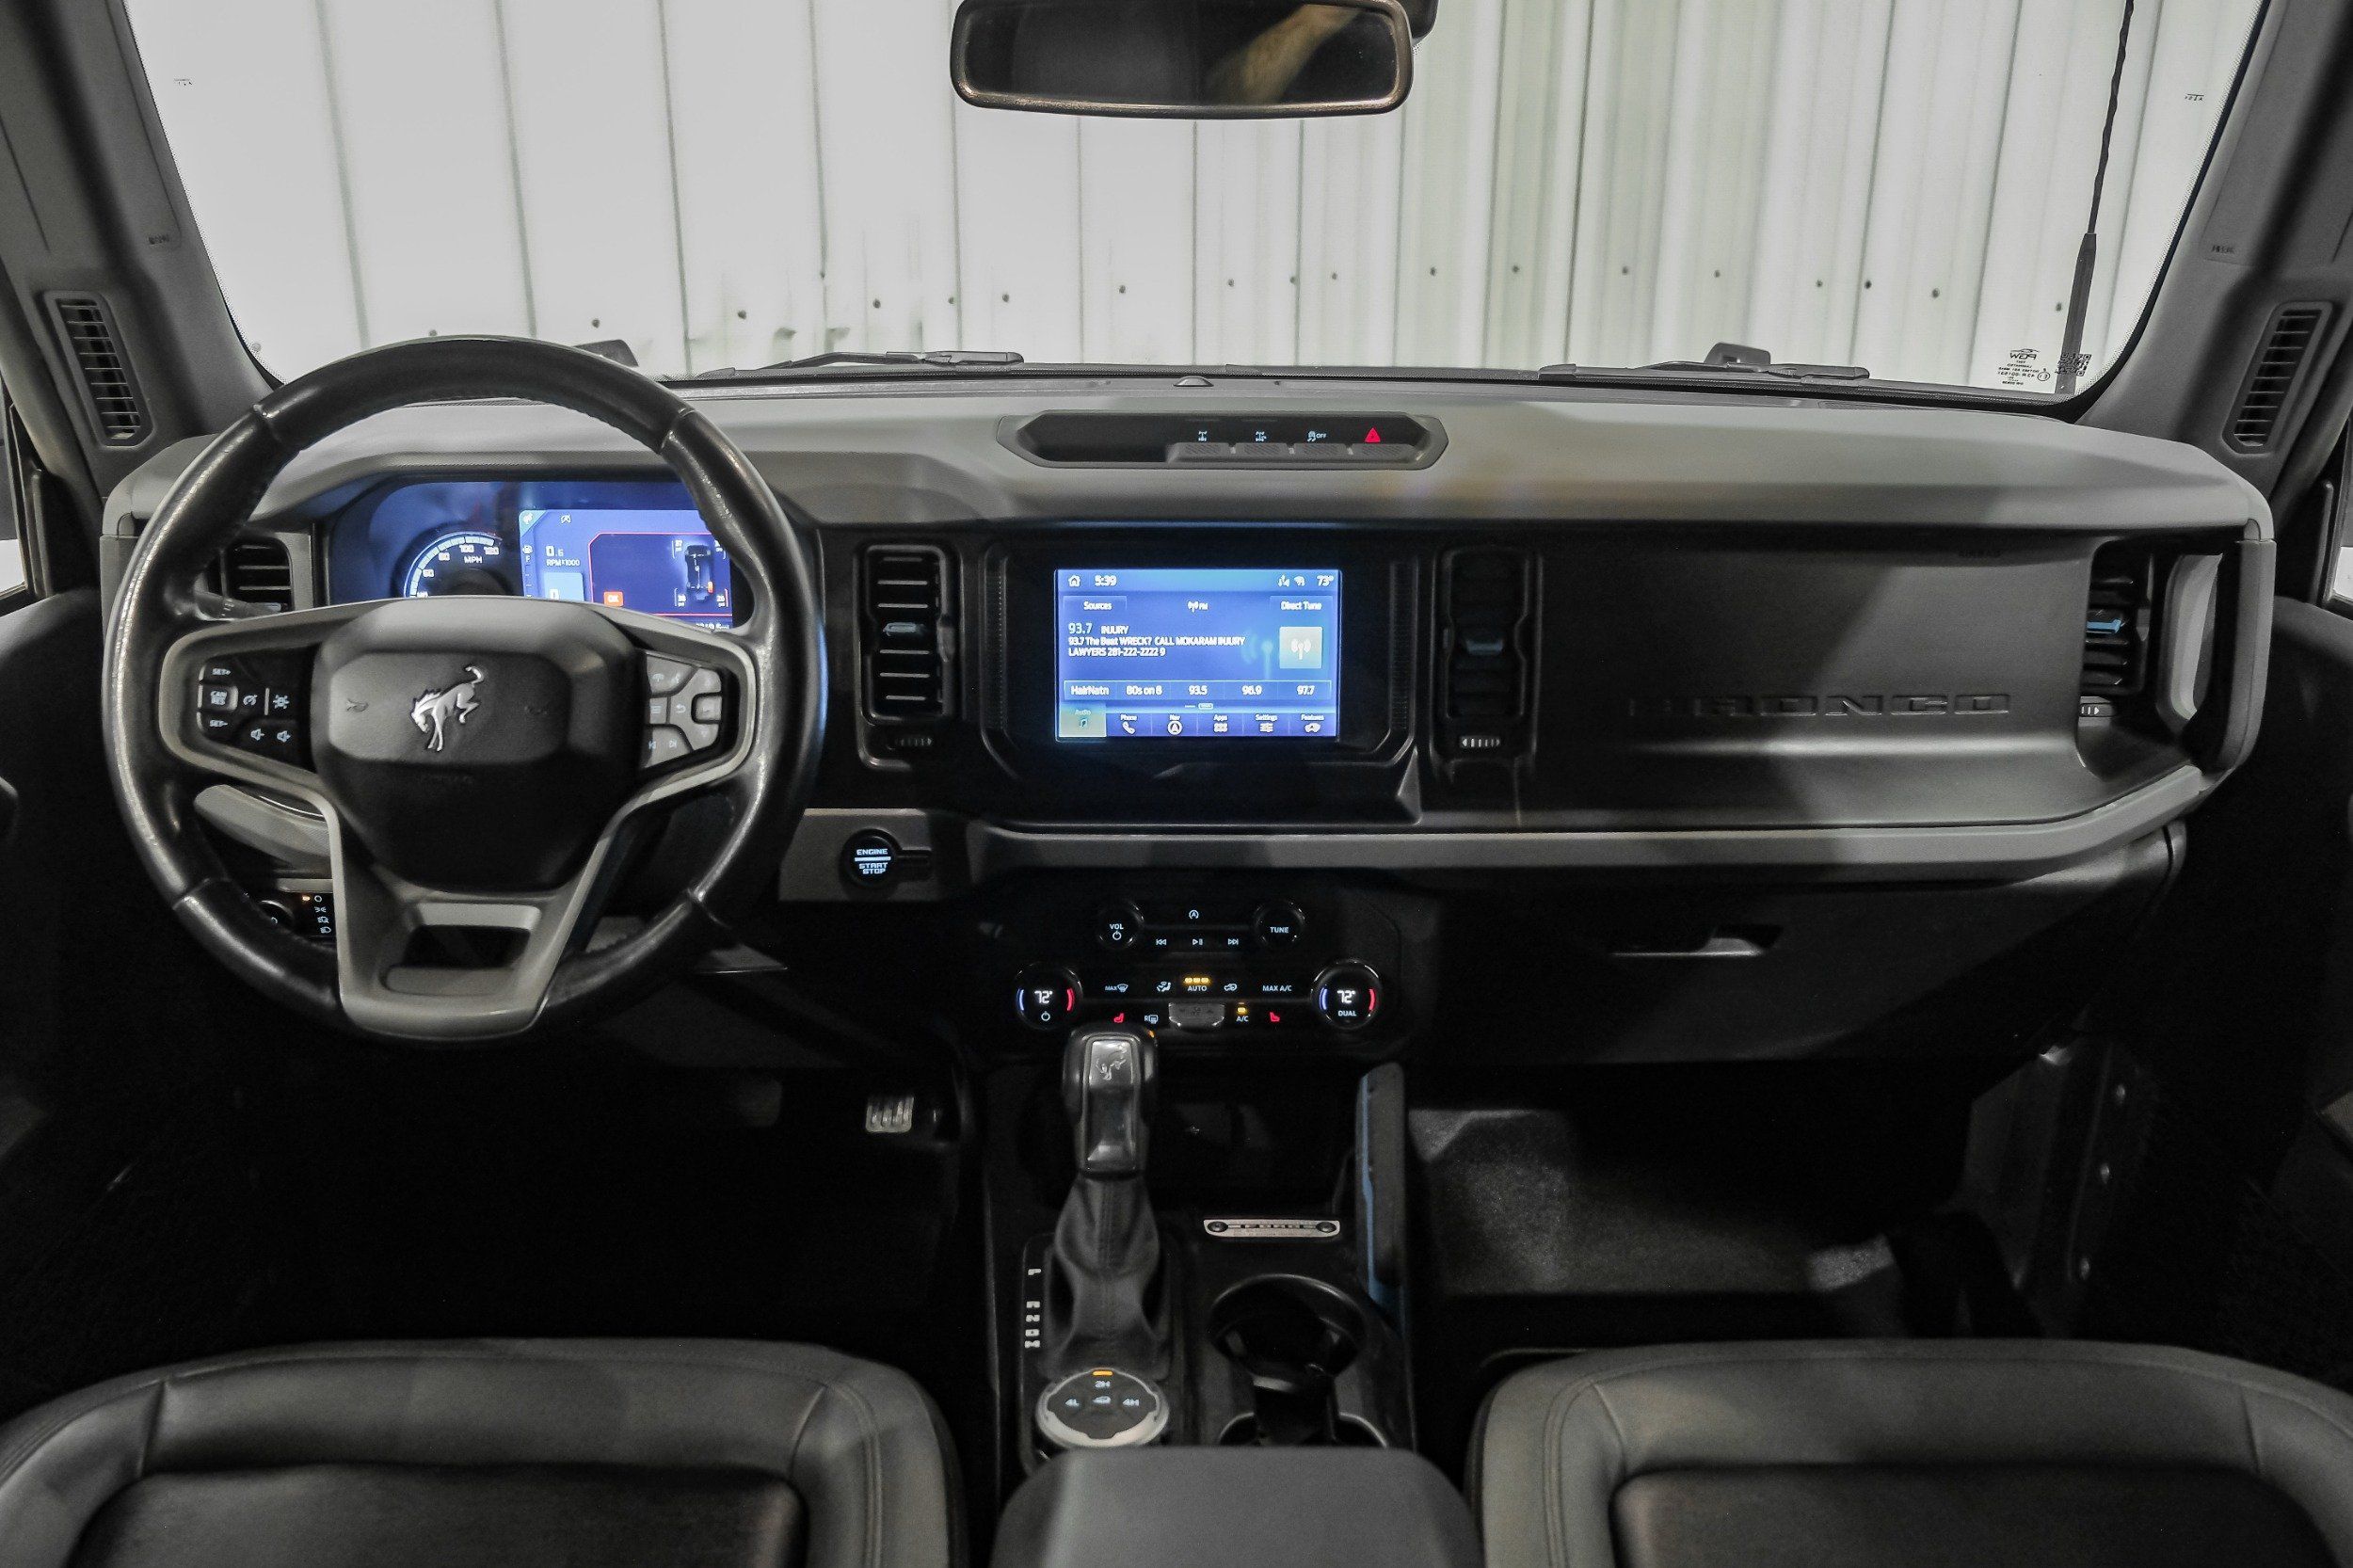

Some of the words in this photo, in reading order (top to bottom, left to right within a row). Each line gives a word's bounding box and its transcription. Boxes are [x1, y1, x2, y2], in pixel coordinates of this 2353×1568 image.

[464, 555, 483, 564] MPH
[1094, 574, 1117, 586] 5:39
[1083, 600, 1112, 610] Sources
[1280, 600, 1302, 611] Direct
[1304, 600, 1322, 611] Tune
[1068, 622, 1093, 634] 93.7
[1100, 625, 1129, 634] INJURY
[1068, 636, 1085, 646] 93.7
[1086, 636, 1099, 646] The
[1100, 636, 1118, 646] Best
[1154, 636, 1175, 646] CALL
[1068, 647, 1107, 657] LAWYERS
[1144, 687, 1155, 696] on
[1188, 685, 1208, 696] 93.5
[1297, 685, 1315, 696] 97.7
[1629, 694, 2011, 717] RONCO
[1255, 713, 1278, 722] Settings
